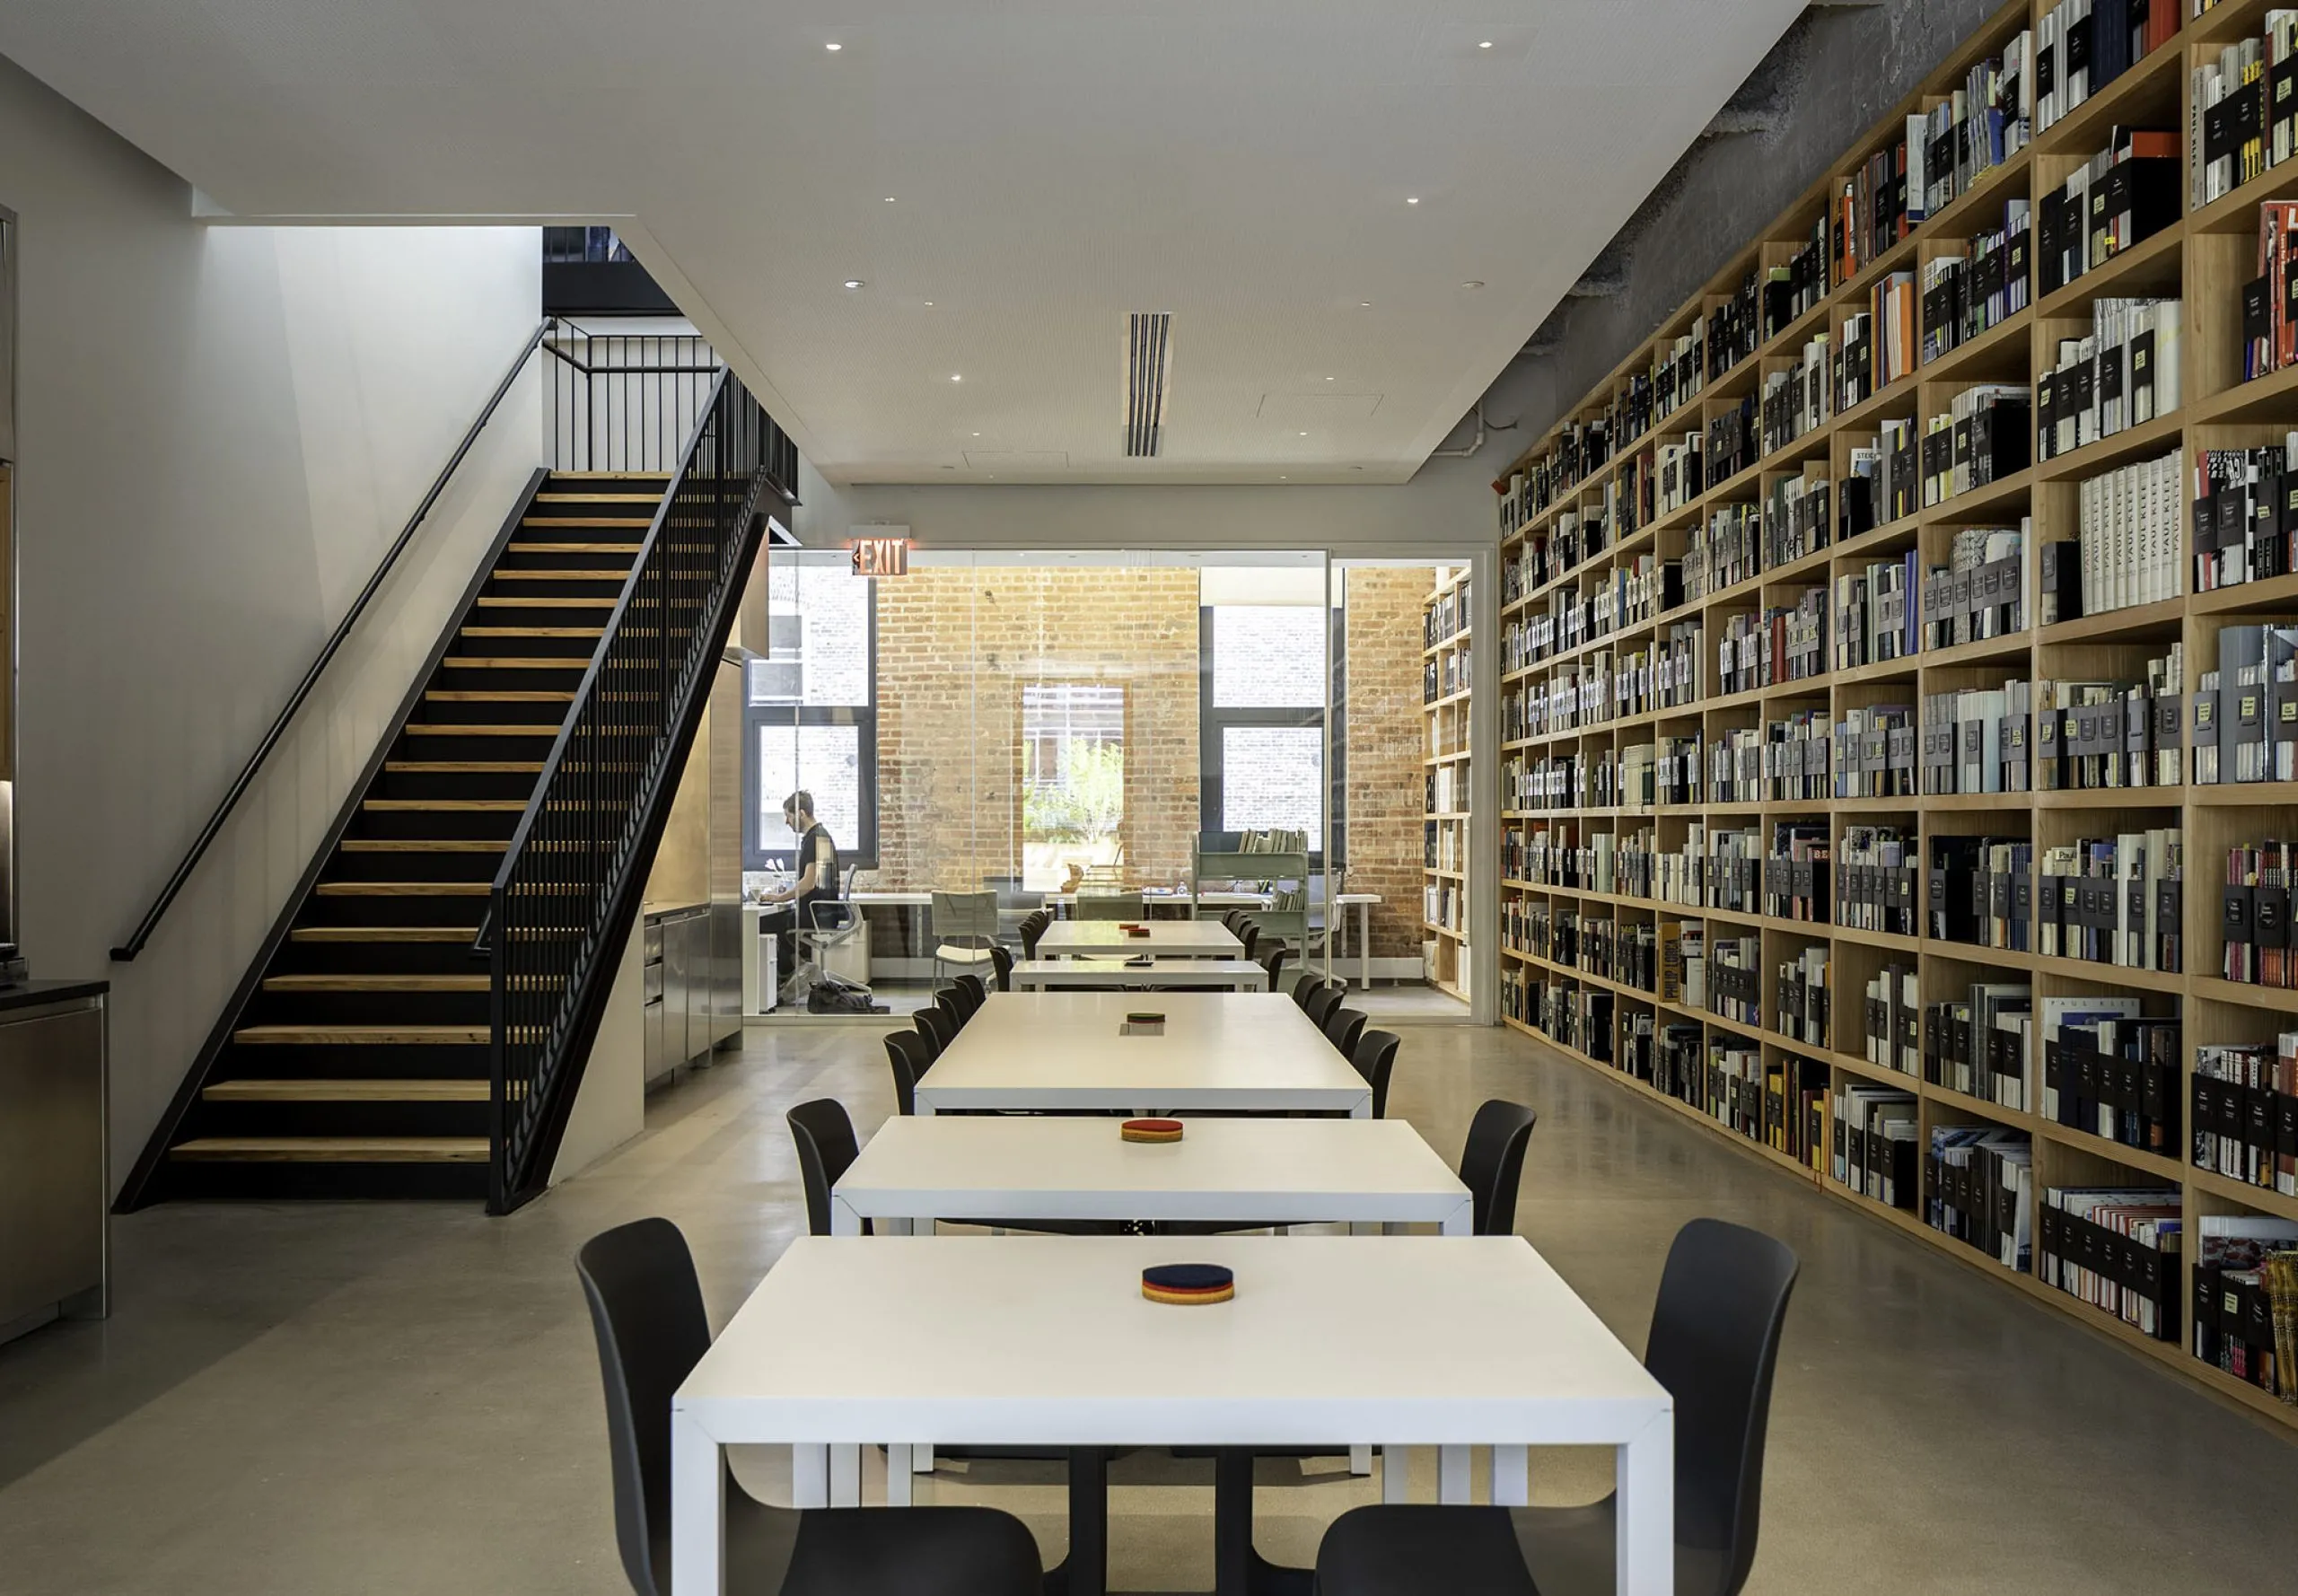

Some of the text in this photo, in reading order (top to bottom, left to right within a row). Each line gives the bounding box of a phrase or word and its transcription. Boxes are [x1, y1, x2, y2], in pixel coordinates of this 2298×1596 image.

[860, 539, 904, 574] EXIT
[1664, 940, 1678, 998] PHILIP LORCA
